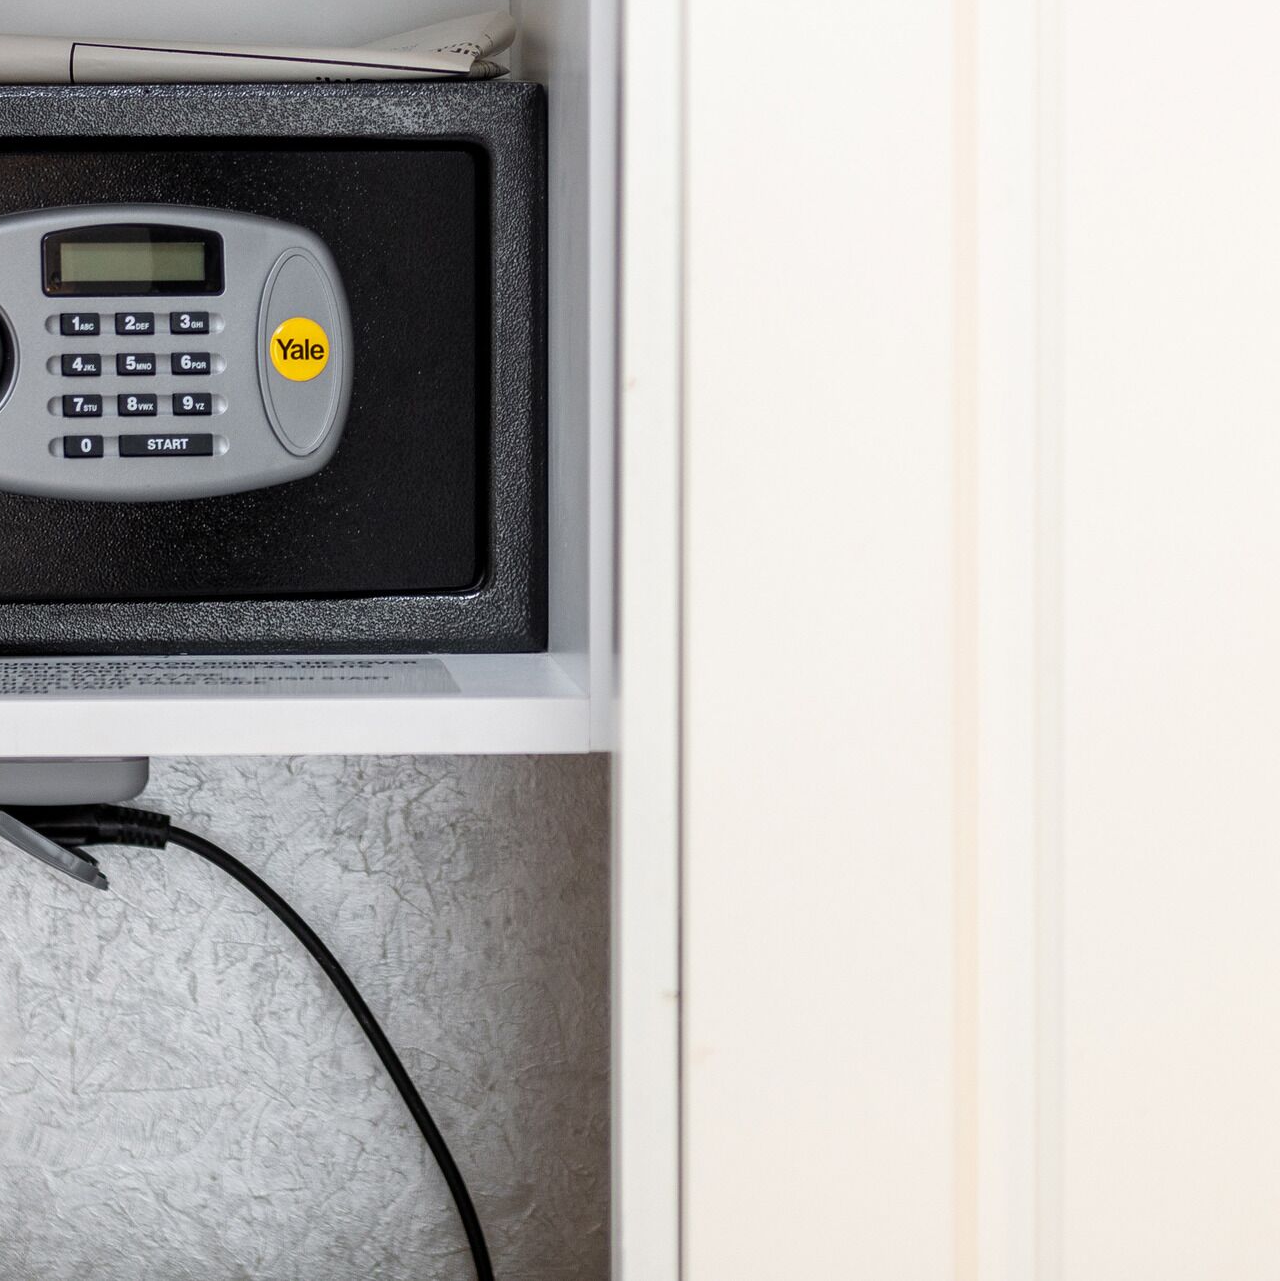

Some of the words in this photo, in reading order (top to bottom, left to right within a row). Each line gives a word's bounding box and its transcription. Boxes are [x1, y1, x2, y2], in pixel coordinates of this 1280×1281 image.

[277, 339, 325, 360] Yale
[81, 439, 92, 453] 0
[147, 438, 189, 450] START
